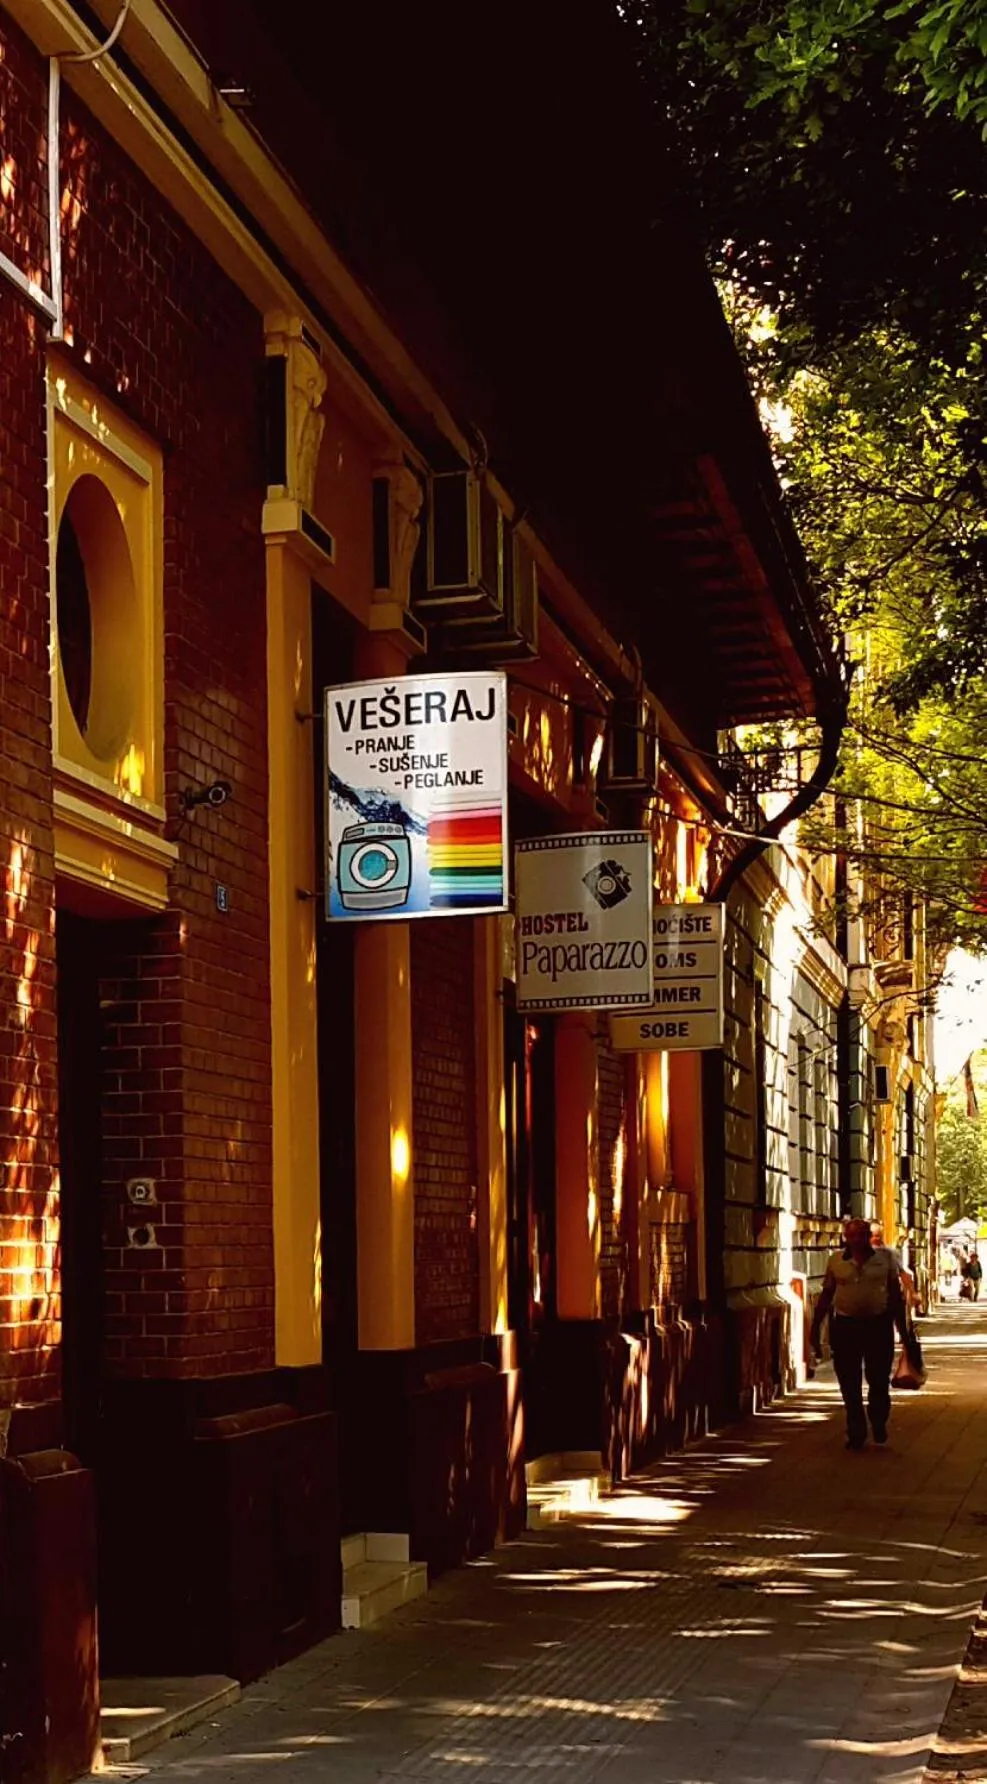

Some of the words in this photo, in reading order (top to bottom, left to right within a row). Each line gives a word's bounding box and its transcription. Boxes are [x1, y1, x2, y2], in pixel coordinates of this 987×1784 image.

[335, 686, 496, 733] VEŠERAJ
[346, 734, 415, 755] -PRANJE
[370, 753, 449, 773] -SUŠENJE
[395, 769, 484, 789] -PEGLANJE
[521, 911, 589, 936] HOSTEL
[653, 913, 712, 934] OĆIŠTE
[522, 940, 648, 982] Paparazzo
[655, 952, 697, 969] OMS
[640, 1021, 689, 1039] SOBE
